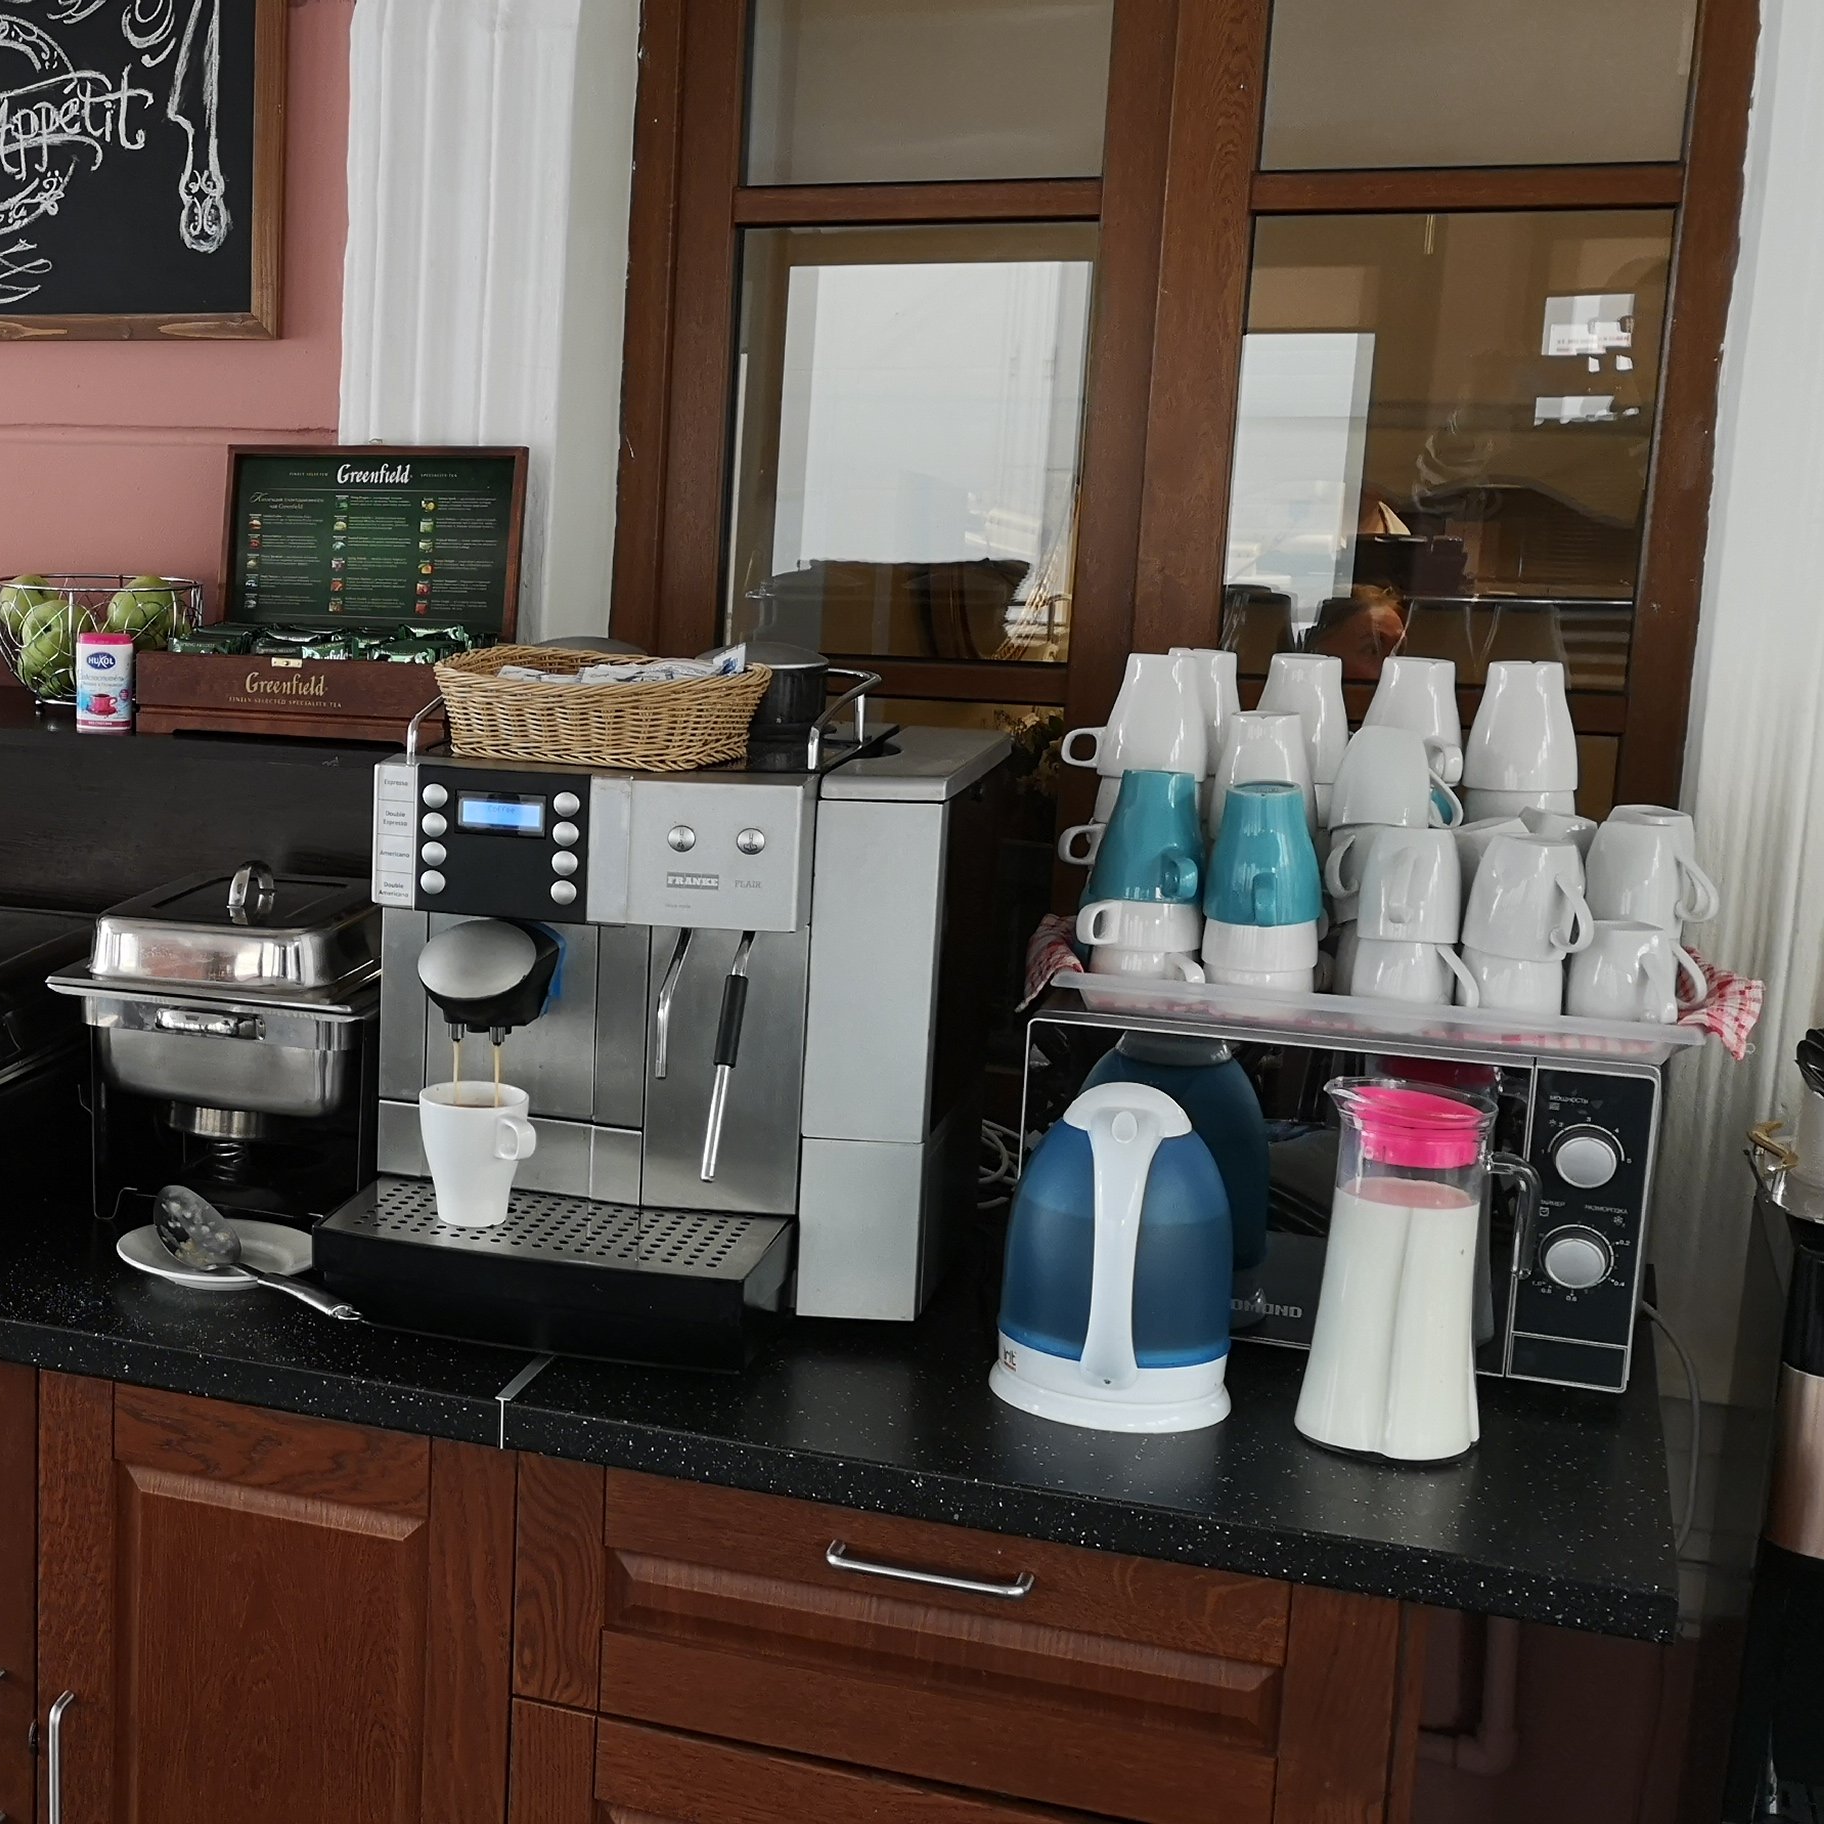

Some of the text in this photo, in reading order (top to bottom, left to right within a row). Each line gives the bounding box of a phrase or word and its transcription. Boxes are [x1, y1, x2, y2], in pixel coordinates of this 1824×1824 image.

[337, 463, 411, 484] Greenfield
[245, 671, 325, 697] Greenfield
[254, 697, 286, 705] SELECTED
[385, 810, 406, 818] Double
[667, 875, 762, 889] FRANKE FLAIR
